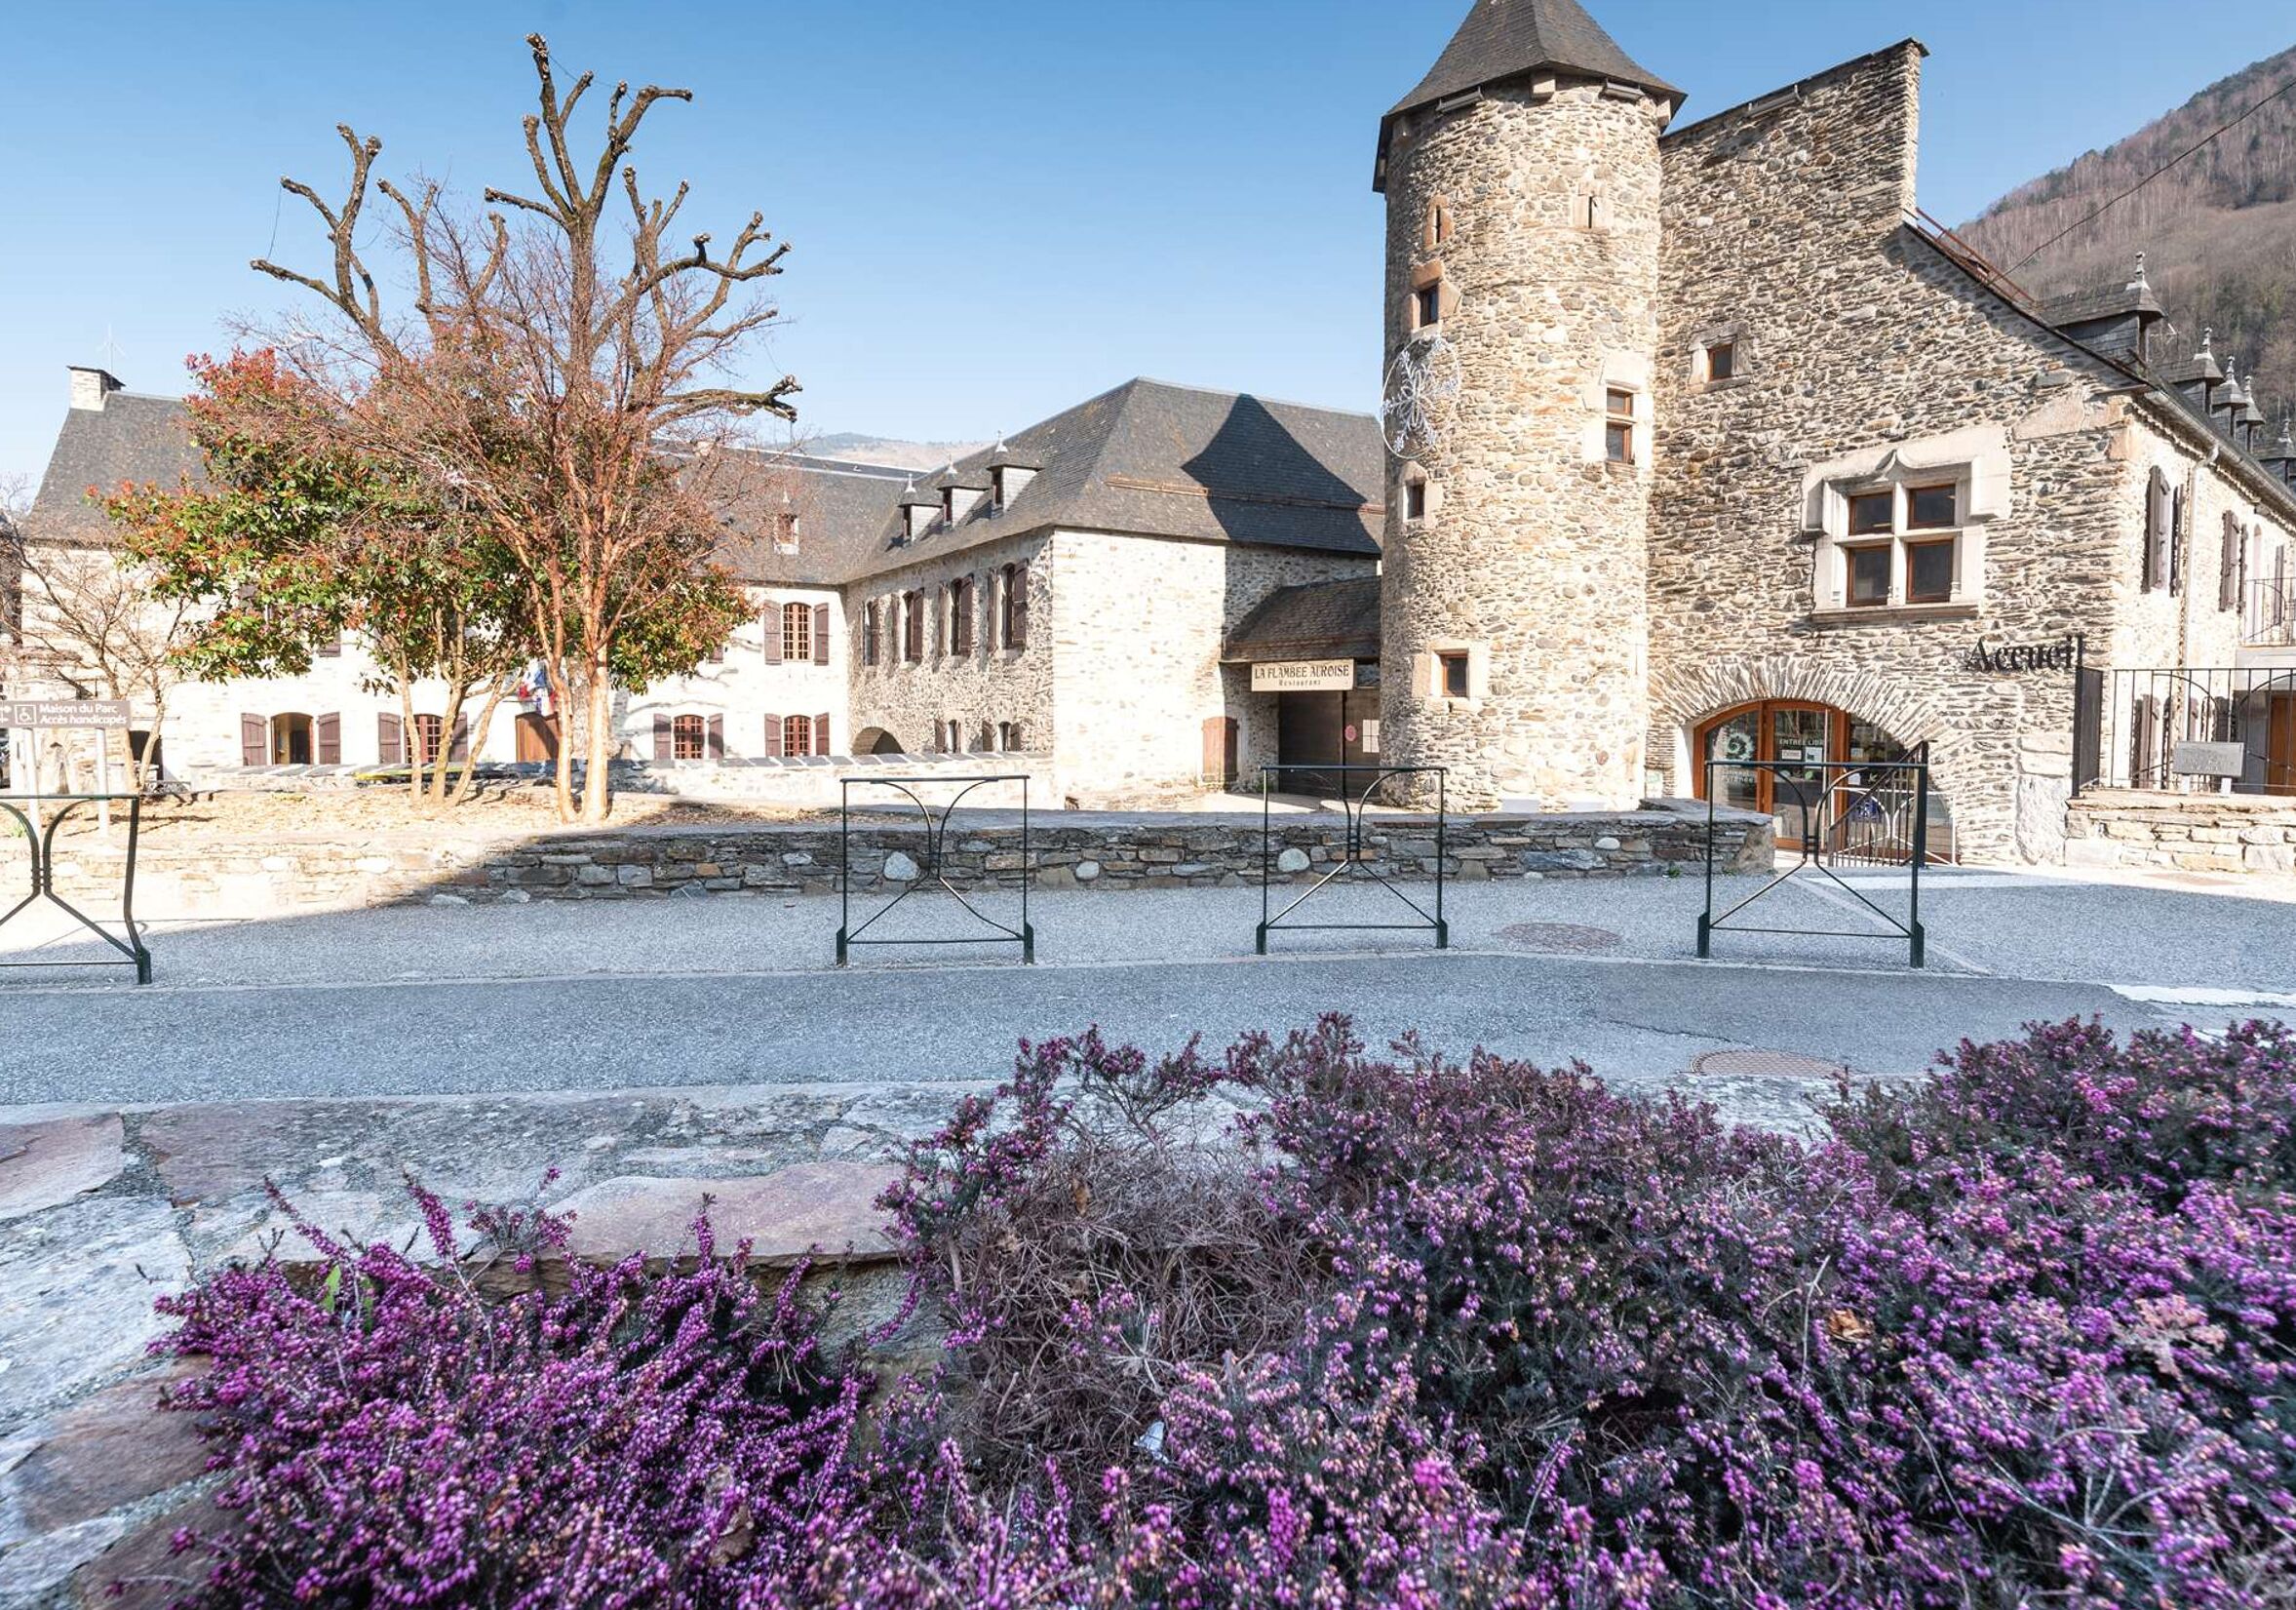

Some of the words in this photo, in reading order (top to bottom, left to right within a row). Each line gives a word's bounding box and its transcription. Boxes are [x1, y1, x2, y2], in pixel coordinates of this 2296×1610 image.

[1965, 632, 2083, 673] Accueil
[1255, 668, 1265, 680] LA
[1309, 664, 1349, 678] AUROISE
[39, 703, 77, 714] Maison
[79, 703, 94, 714] du
[95, 703, 118, 714] Parc
[40, 715, 68, 725] Accès
[69, 714, 128, 726] handicapés
